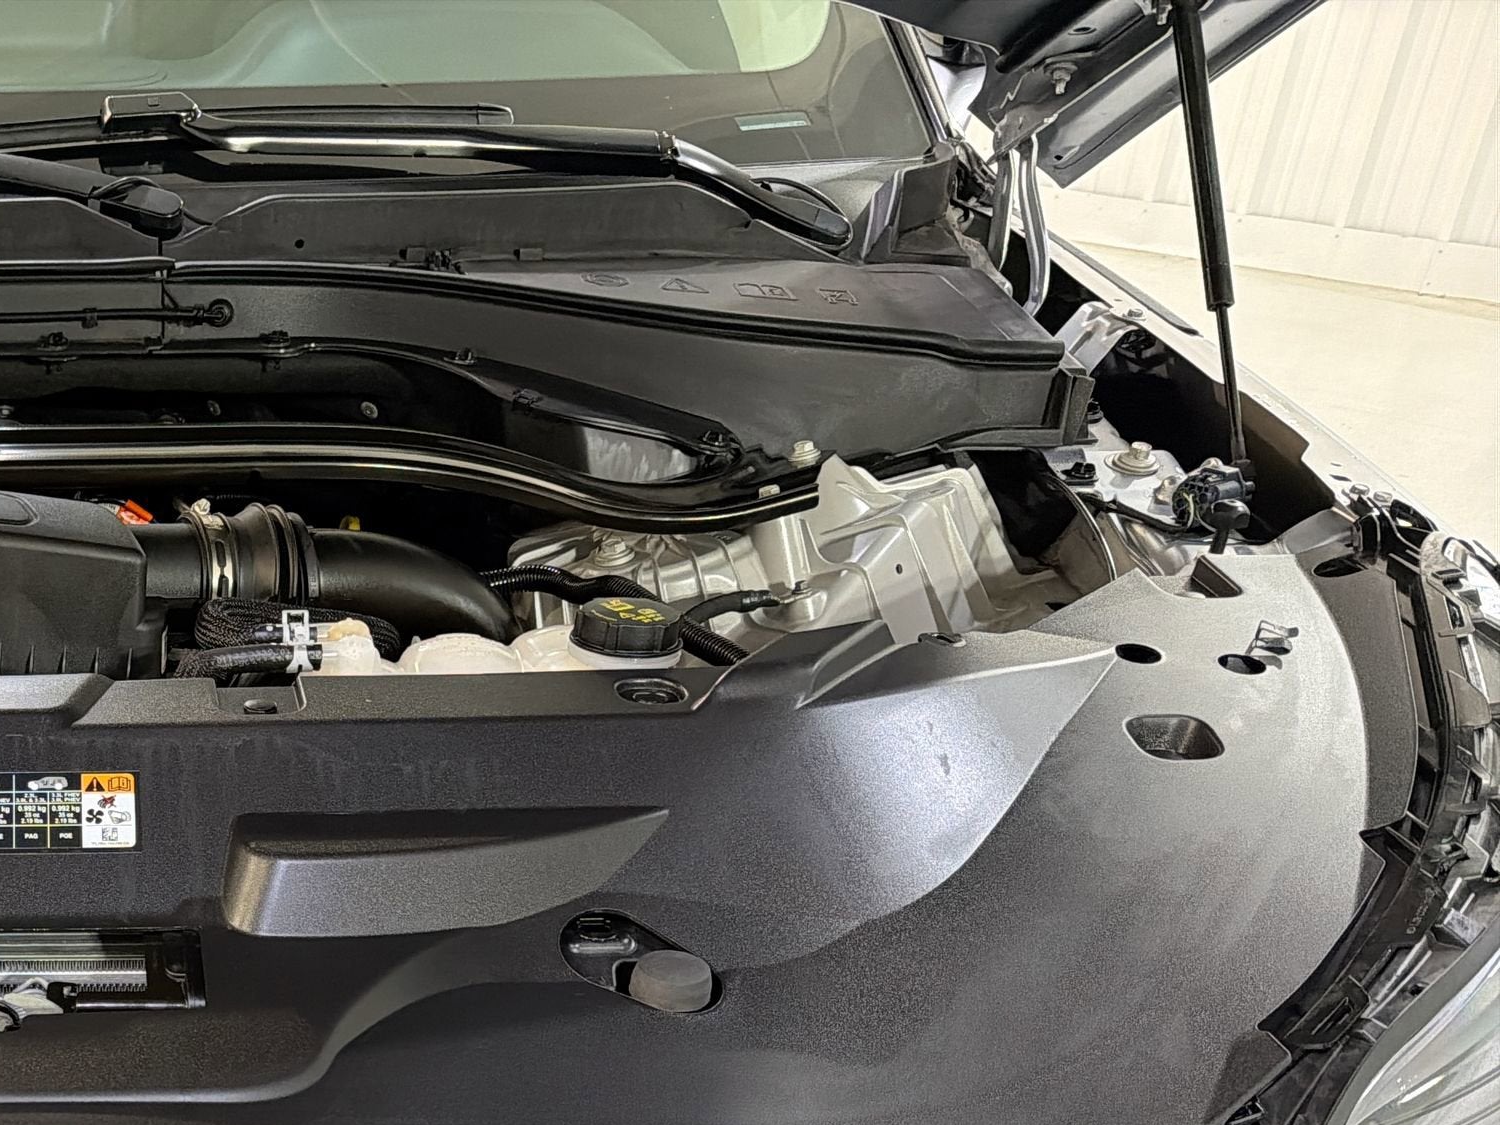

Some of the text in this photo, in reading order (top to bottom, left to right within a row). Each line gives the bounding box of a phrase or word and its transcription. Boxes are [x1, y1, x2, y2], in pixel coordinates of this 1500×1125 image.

[1, 806, 10, 814] kg
[37, 805, 46, 813] kg
[71, 805, 80, 813] kg
